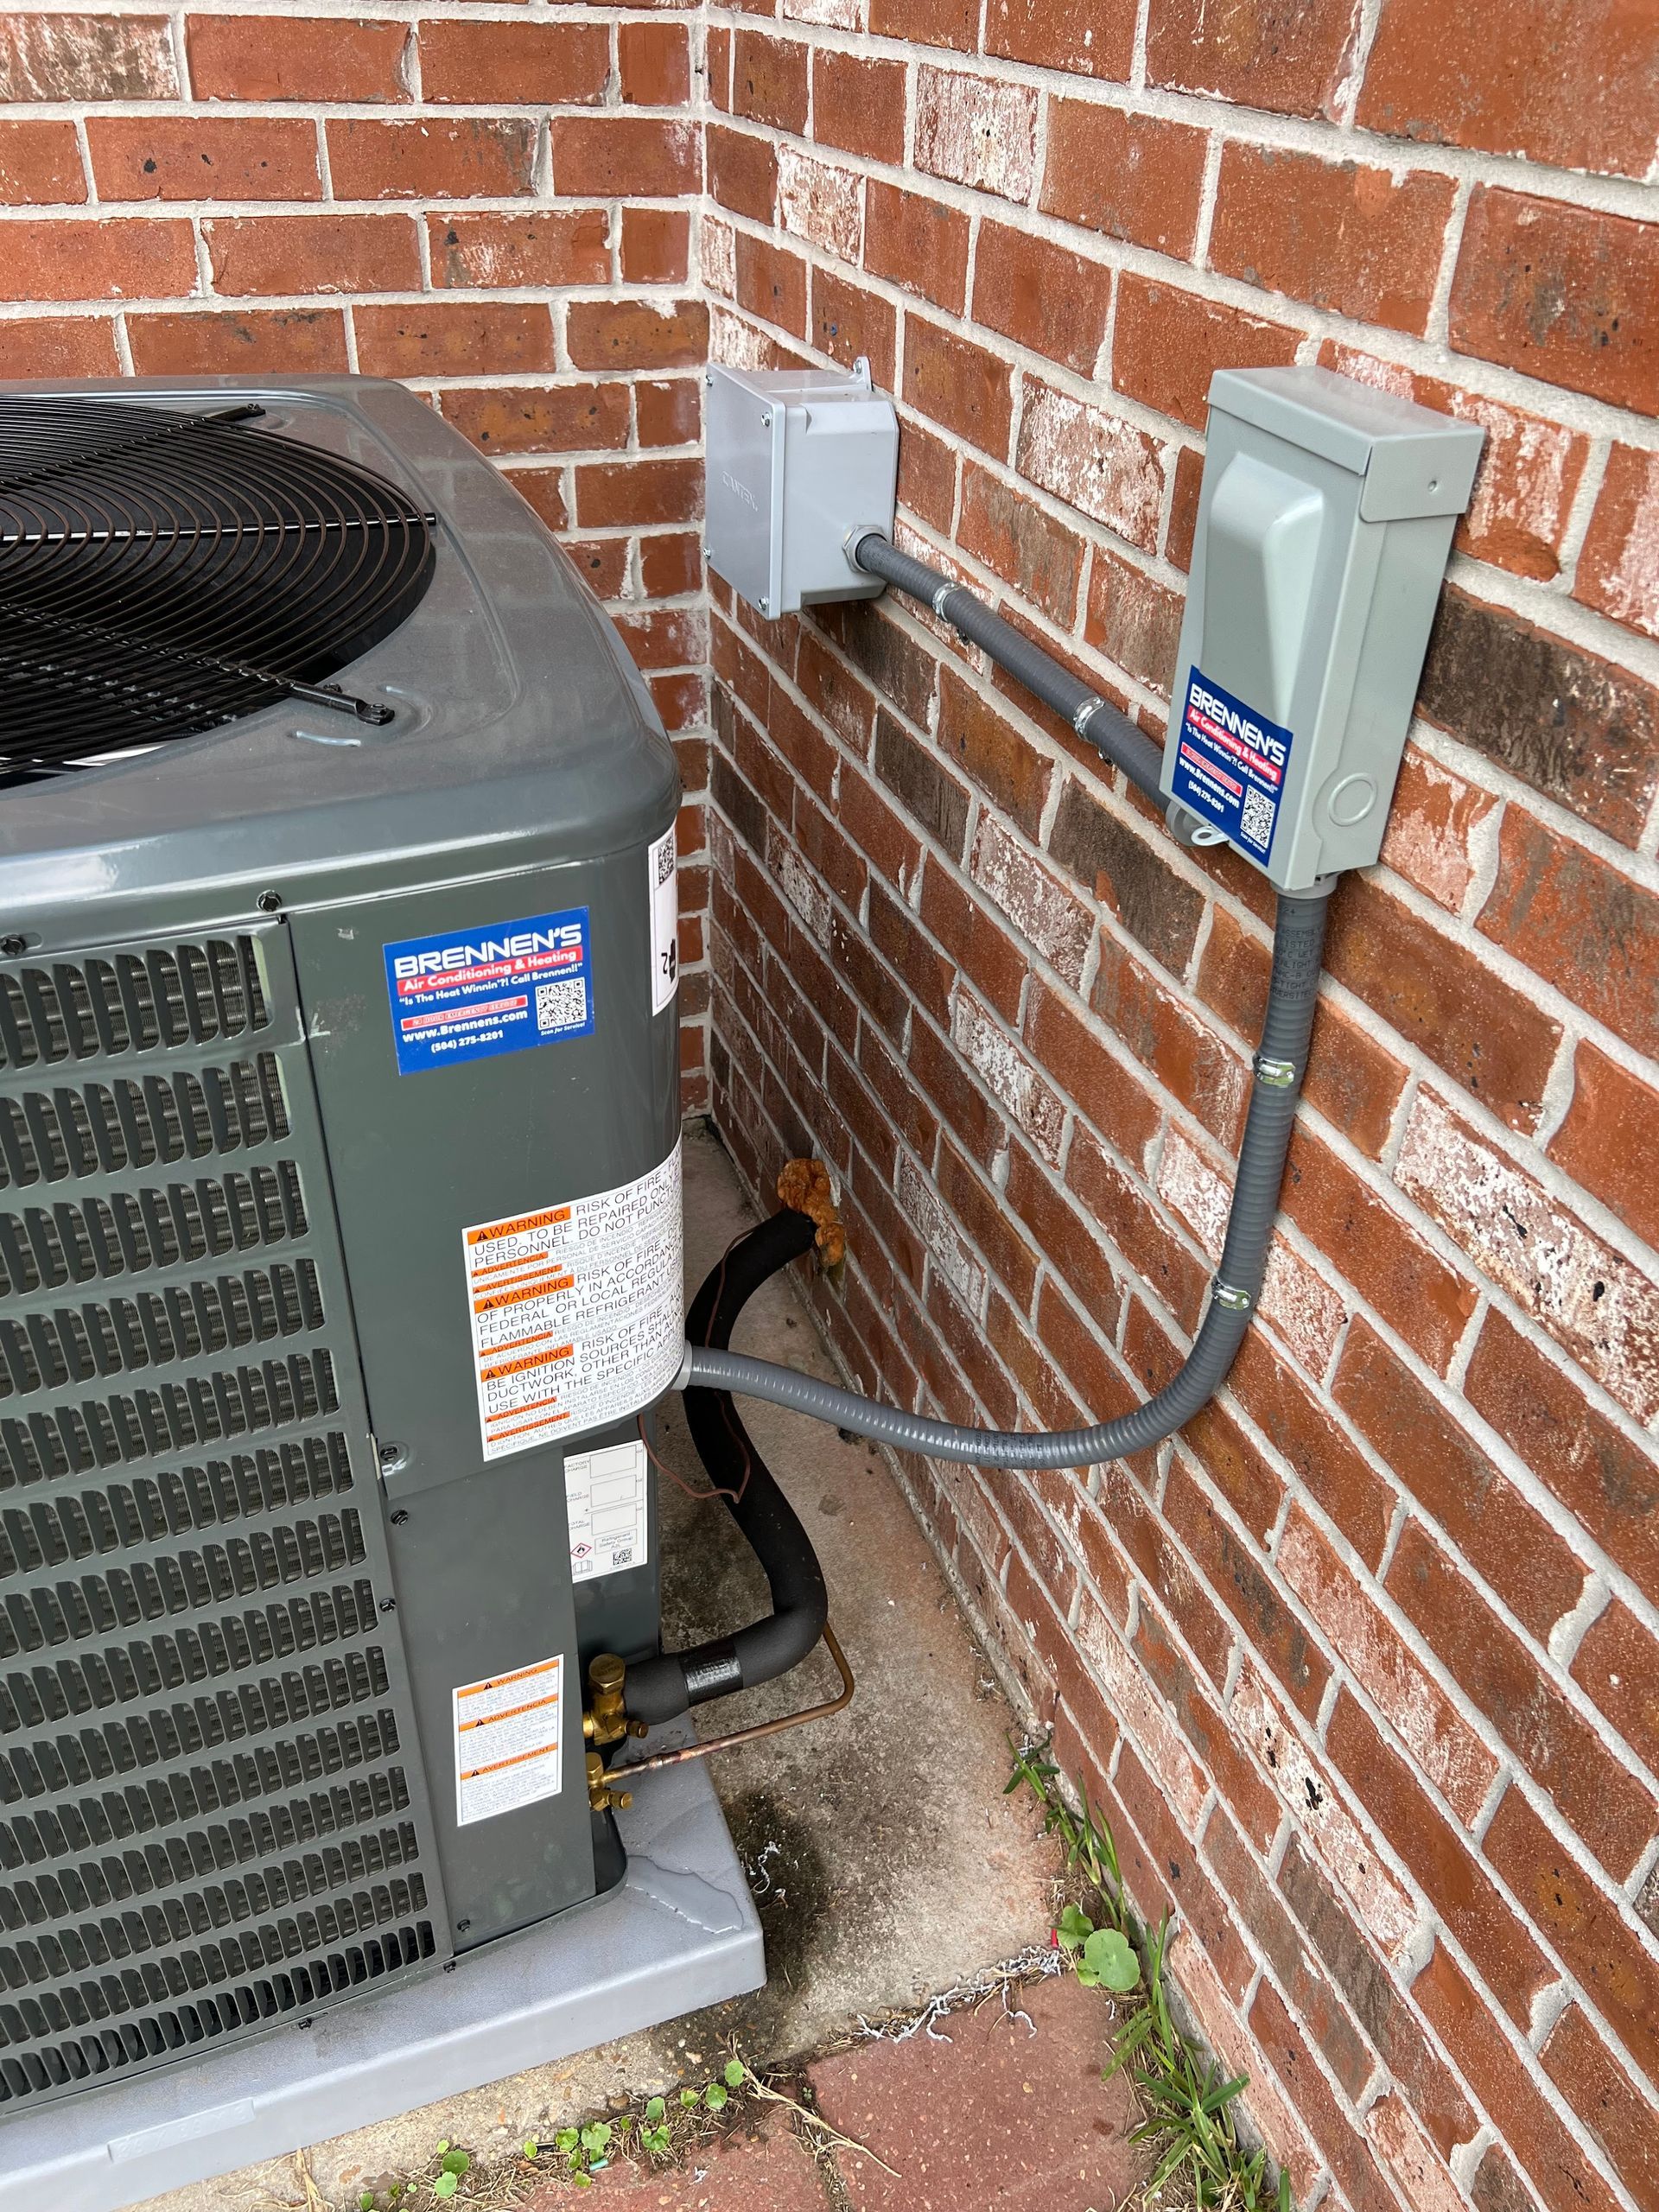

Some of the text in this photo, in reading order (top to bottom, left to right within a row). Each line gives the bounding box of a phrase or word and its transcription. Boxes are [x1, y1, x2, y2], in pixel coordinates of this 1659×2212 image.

[1189, 683, 1287, 766] BRENNEN'S
[1190, 709, 1200, 722] Air
[1200, 715, 1242, 757] Conditioning
[1242, 746, 1249, 759] &
[1249, 749, 1278, 781] Heating
[1179, 757, 1240, 809] www.Brennens.com
[394, 924, 582, 978] BRENNEN'S
[404, 950, 577, 992] Air Conditioning & Heating
[415, 992, 434, 1003] The
[435, 988, 461, 1000] Heat
[511, 974, 531, 986] Call
[402, 1009, 528, 1043] www.Brennens.com
[430, 1029, 504, 1053] (504) 275-8201
[474, 1236, 522, 1255] USED.
[527, 1228, 549, 1242] TO
[553, 1222, 573, 1236] BE
[578, 1195, 647, 1229] REPAIRED
[650, 1173, 673, 1199] ONLY
[489, 1210, 565, 1237] WARNING
[576, 1198, 610, 1216] RISK
[614, 1189, 632, 1204] OF
[637, 1172, 661, 1195] FIRE
[474, 1236, 574, 1268] PERSONNEL.
[578, 1225, 601, 1240] DO
[605, 1214, 633, 1233] NOT
[481, 1254, 544, 1275] ADVERTENCIA
[556, 1242, 585, 1255] RIESGO
[486, 1265, 558, 1290] AVERTISSEMENT
[495, 1239, 660, 1306] WARNING RISK OF FIRE
[527, 1262, 544, 1270] POR
[477, 1309, 499, 1324] OF
[504, 1285, 584, 1317] PROPERLY
[589, 1280, 602, 1293] IN
[480, 1309, 550, 1336] FEDERAL
[556, 1300, 577, 1313] OR
[582, 1285, 628, 1306] LOCAL
[481, 1314, 571, 1348] FLAMMABLE
[575, 1272, 665, 1321] REFRIGERANT
[485, 1354, 494, 1363] DE
[536, 1338, 552, 1348] CON
[554, 1333, 568, 1342] LAS
[486, 1377, 505, 1391] BE
[512, 1357, 575, 1384] IGNITION
[580, 1331, 645, 1363] SOURCES
[648, 1306, 675, 1335] SHALL
[493, 1332, 551, 1352] ADVERTENCIA
[555, 1323, 583, 1335] RIESGO
[498, 1347, 569, 1375] WARNING
[582, 1332, 614, 1351] RISK
[618, 1323, 635, 1338] OF
[639, 1305, 663, 1329] FIRE
[487, 1368, 577, 1402] DUCTWORK.
[582, 1350, 629, 1373] OTHER
[633, 1331, 662, 1353] THAN
[488, 1398, 518, 1414] USE
[523, 1384, 560, 1403] WITH
[564, 1374, 592, 1390] THE
[596, 1347, 655, 1381] SPECIFIC
[498, 1397, 556, 1419] ADVERTENCIA
[560, 1388, 588, 1400] RIESGO
[590, 1384, 600, 1393] DE
[499, 1413, 567, 1438] AVERTISSEMENT
[496, 1667, 537, 1686] WARNING
[488, 1699, 546, 1722] ADVERTENCIA
[482, 1746, 550, 1773] AVERTISSEMENT
